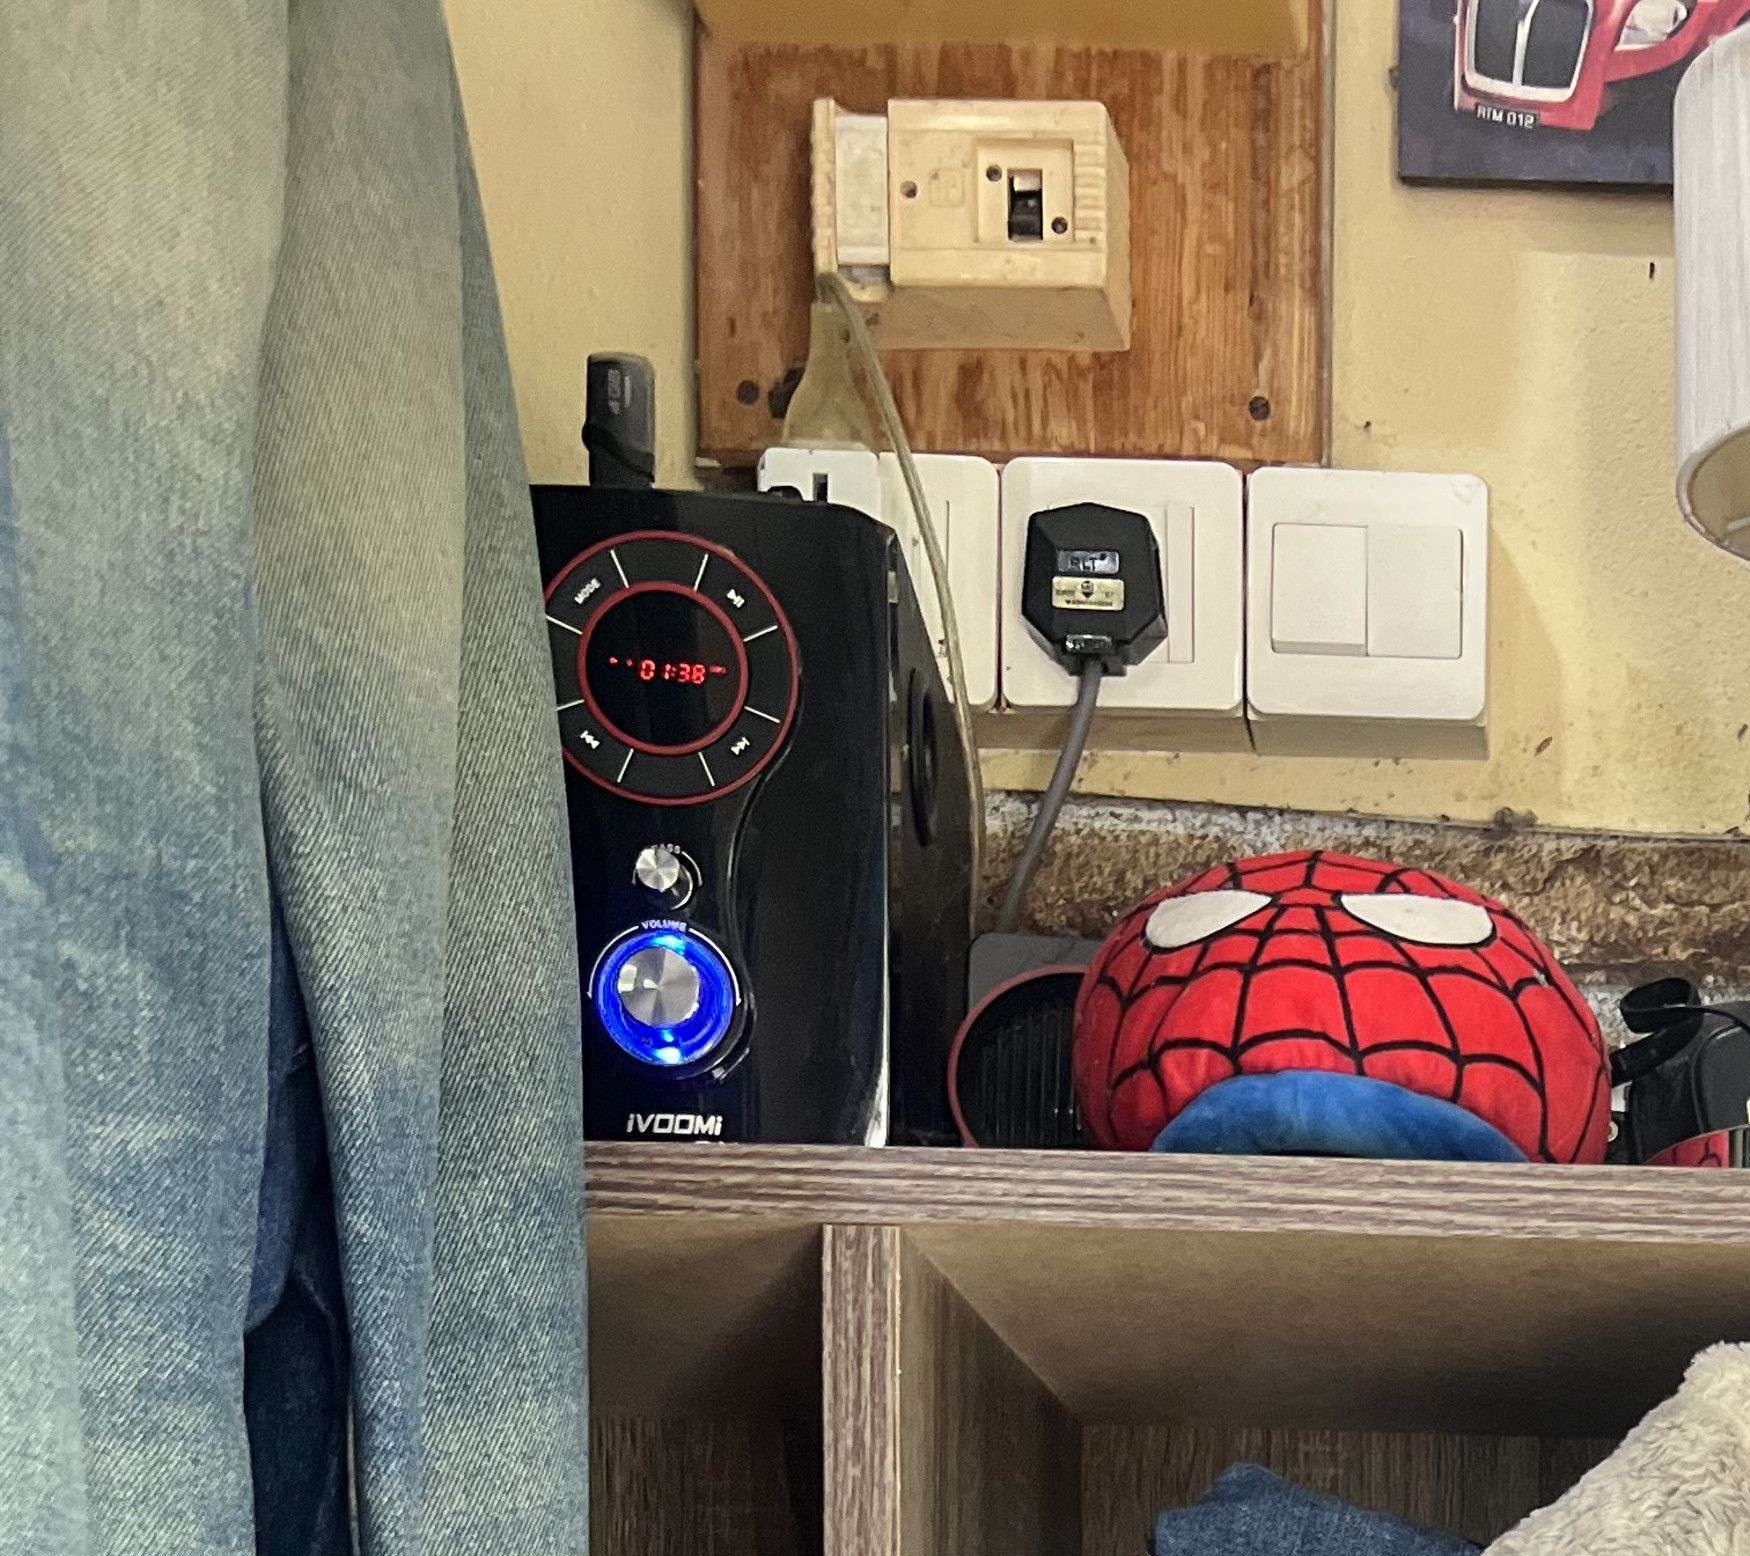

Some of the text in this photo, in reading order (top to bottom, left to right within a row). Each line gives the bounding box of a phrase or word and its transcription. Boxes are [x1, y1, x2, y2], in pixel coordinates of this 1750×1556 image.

[575, 578, 600, 605] MODE
[640, 659, 706, 685] 01:38
[641, 920, 687, 932] VOLUME
